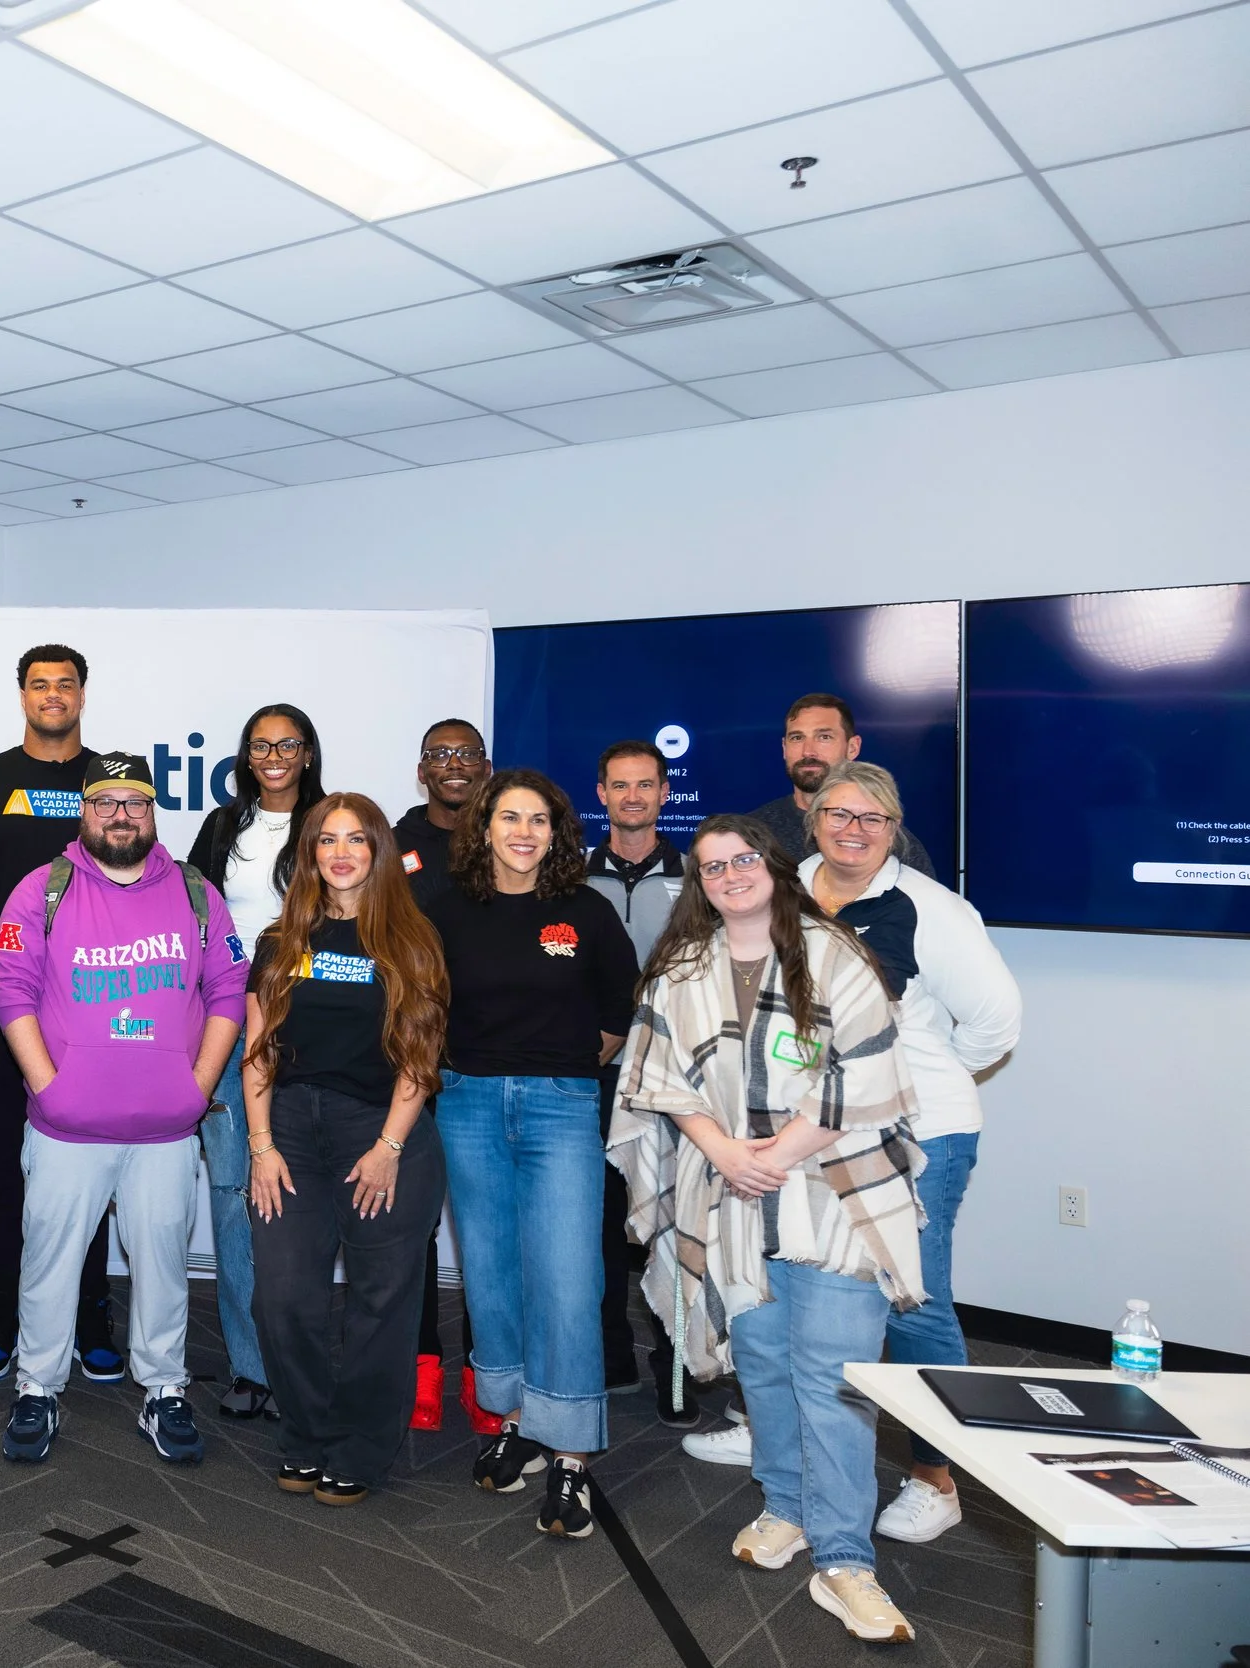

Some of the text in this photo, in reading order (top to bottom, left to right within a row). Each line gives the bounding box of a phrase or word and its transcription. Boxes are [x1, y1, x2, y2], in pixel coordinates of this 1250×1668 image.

[667, 768, 688, 777] MI 2
[32, 791, 82, 801] ARMSTEA
[666, 790, 699, 804] Signal
[33, 799, 79, 809] ACADEM
[43, 808, 82, 817] PROJEC
[1176, 821, 1187, 829] (1)
[1188, 821, 1212, 829] Check
[1229, 822, 1250, 830] cable
[1208, 835, 1219, 844] (2)
[1220, 835, 1243, 844] Press
[1175, 869, 1236, 880] Connection
[72, 932, 187, 967] ARIZONA
[314, 952, 375, 967] ARMSTEAD
[313, 960, 373, 975] ACADEMIC
[322, 971, 371, 982] PROJECT
[71, 963, 186, 1005] SUPER BOWL
